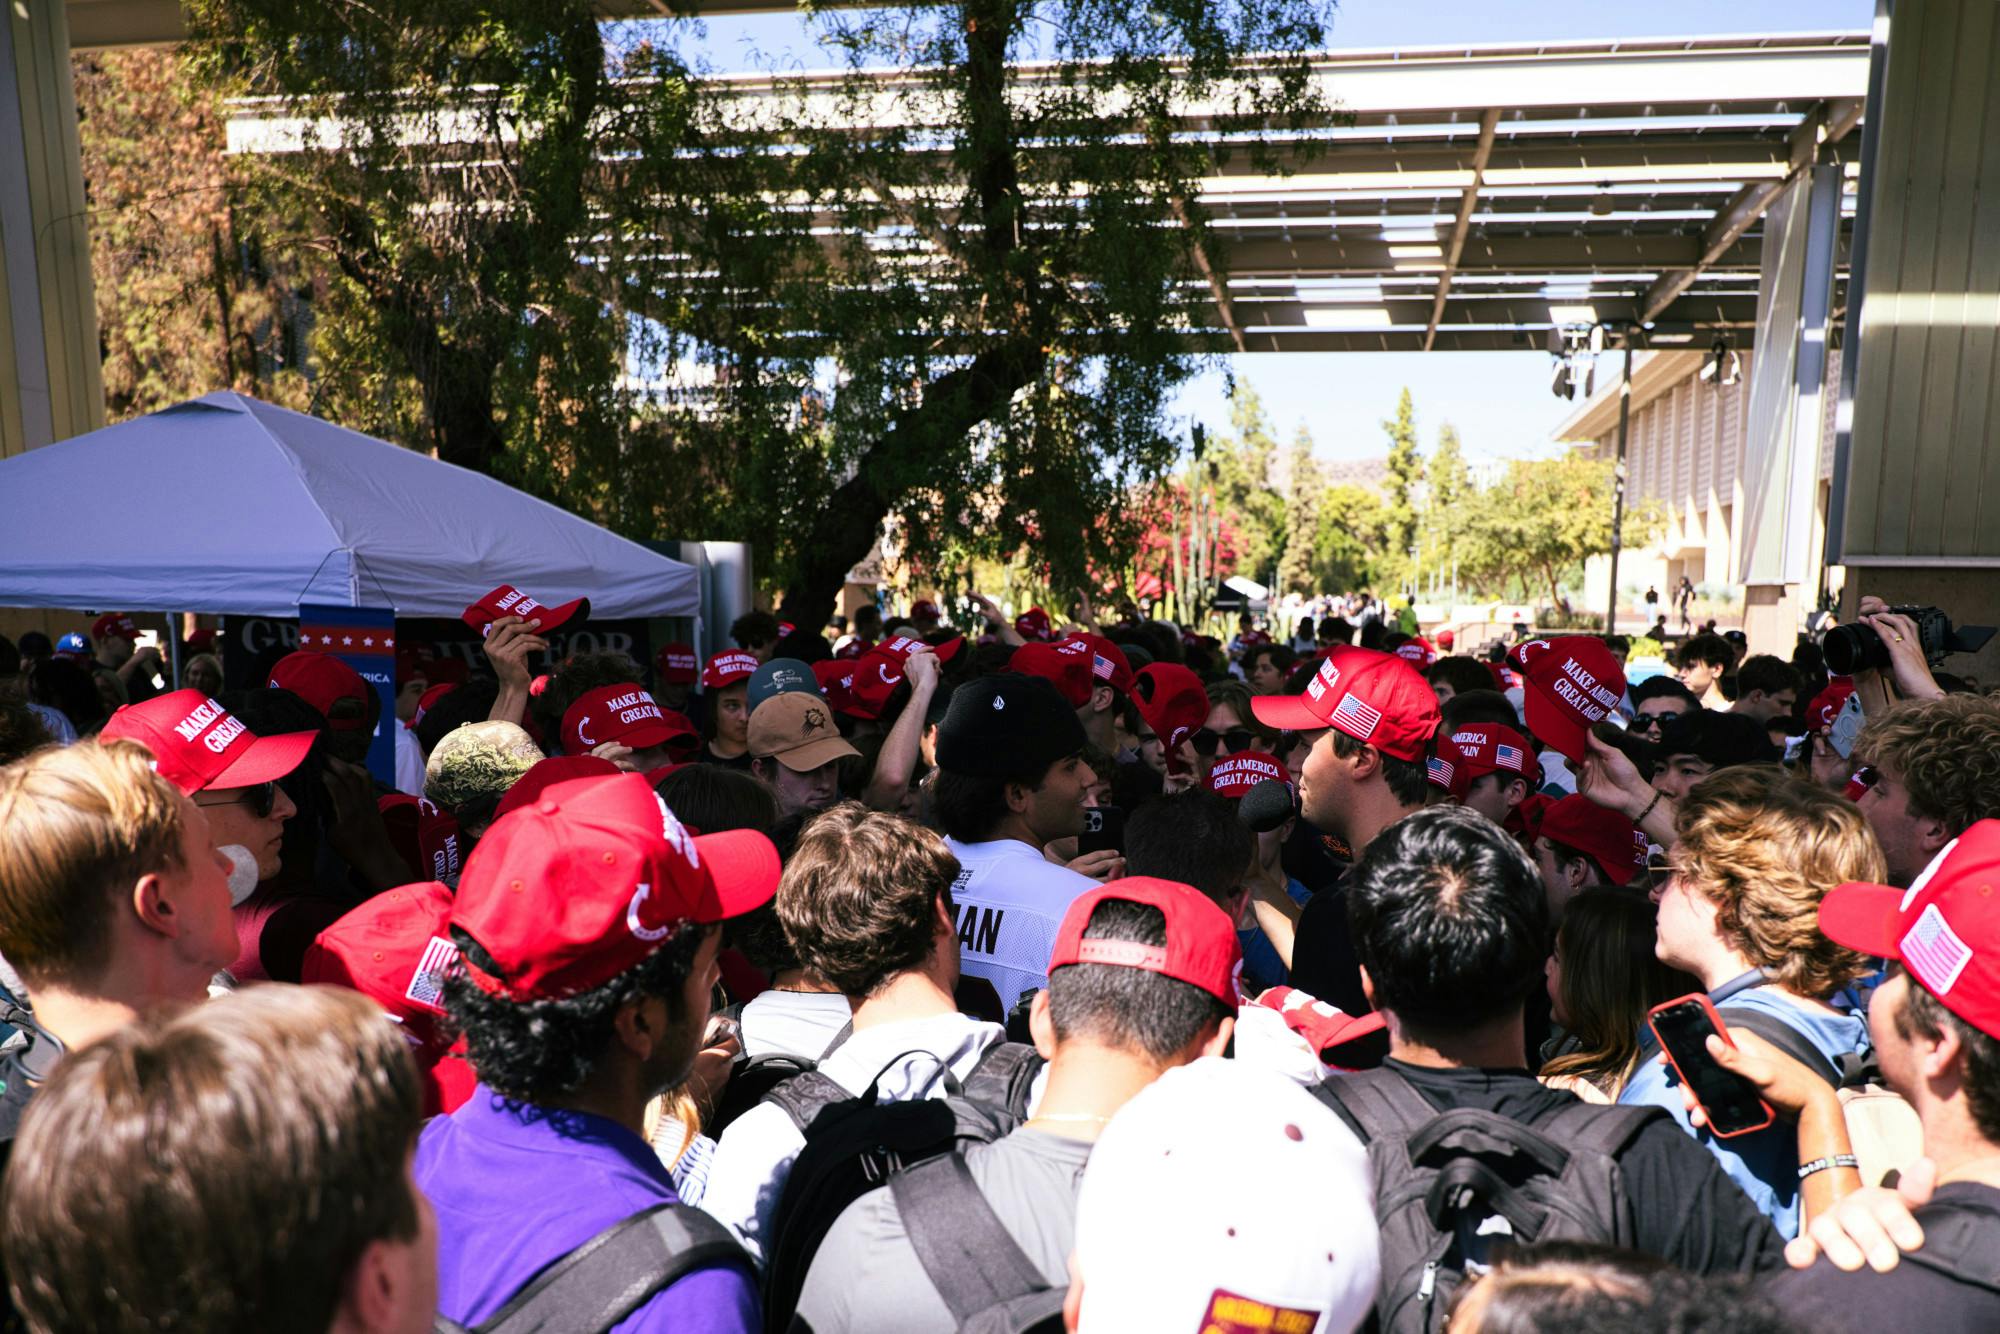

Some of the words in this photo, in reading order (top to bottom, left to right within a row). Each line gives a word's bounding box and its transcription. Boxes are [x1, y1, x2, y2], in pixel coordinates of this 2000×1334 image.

[1561, 657, 1596, 690] MAKE
[606, 692, 639, 712] MAKE
[1553, 678, 1590, 711] GREAT
[174, 704, 218, 742] MAKE
[620, 705, 654, 724] GREAT
[1211, 760, 1235, 778] MAKE
[1235, 759, 1279, 777] AMERICA
[1214, 772, 1243, 790] GREAT
[444, 834, 458, 873] MAKE
